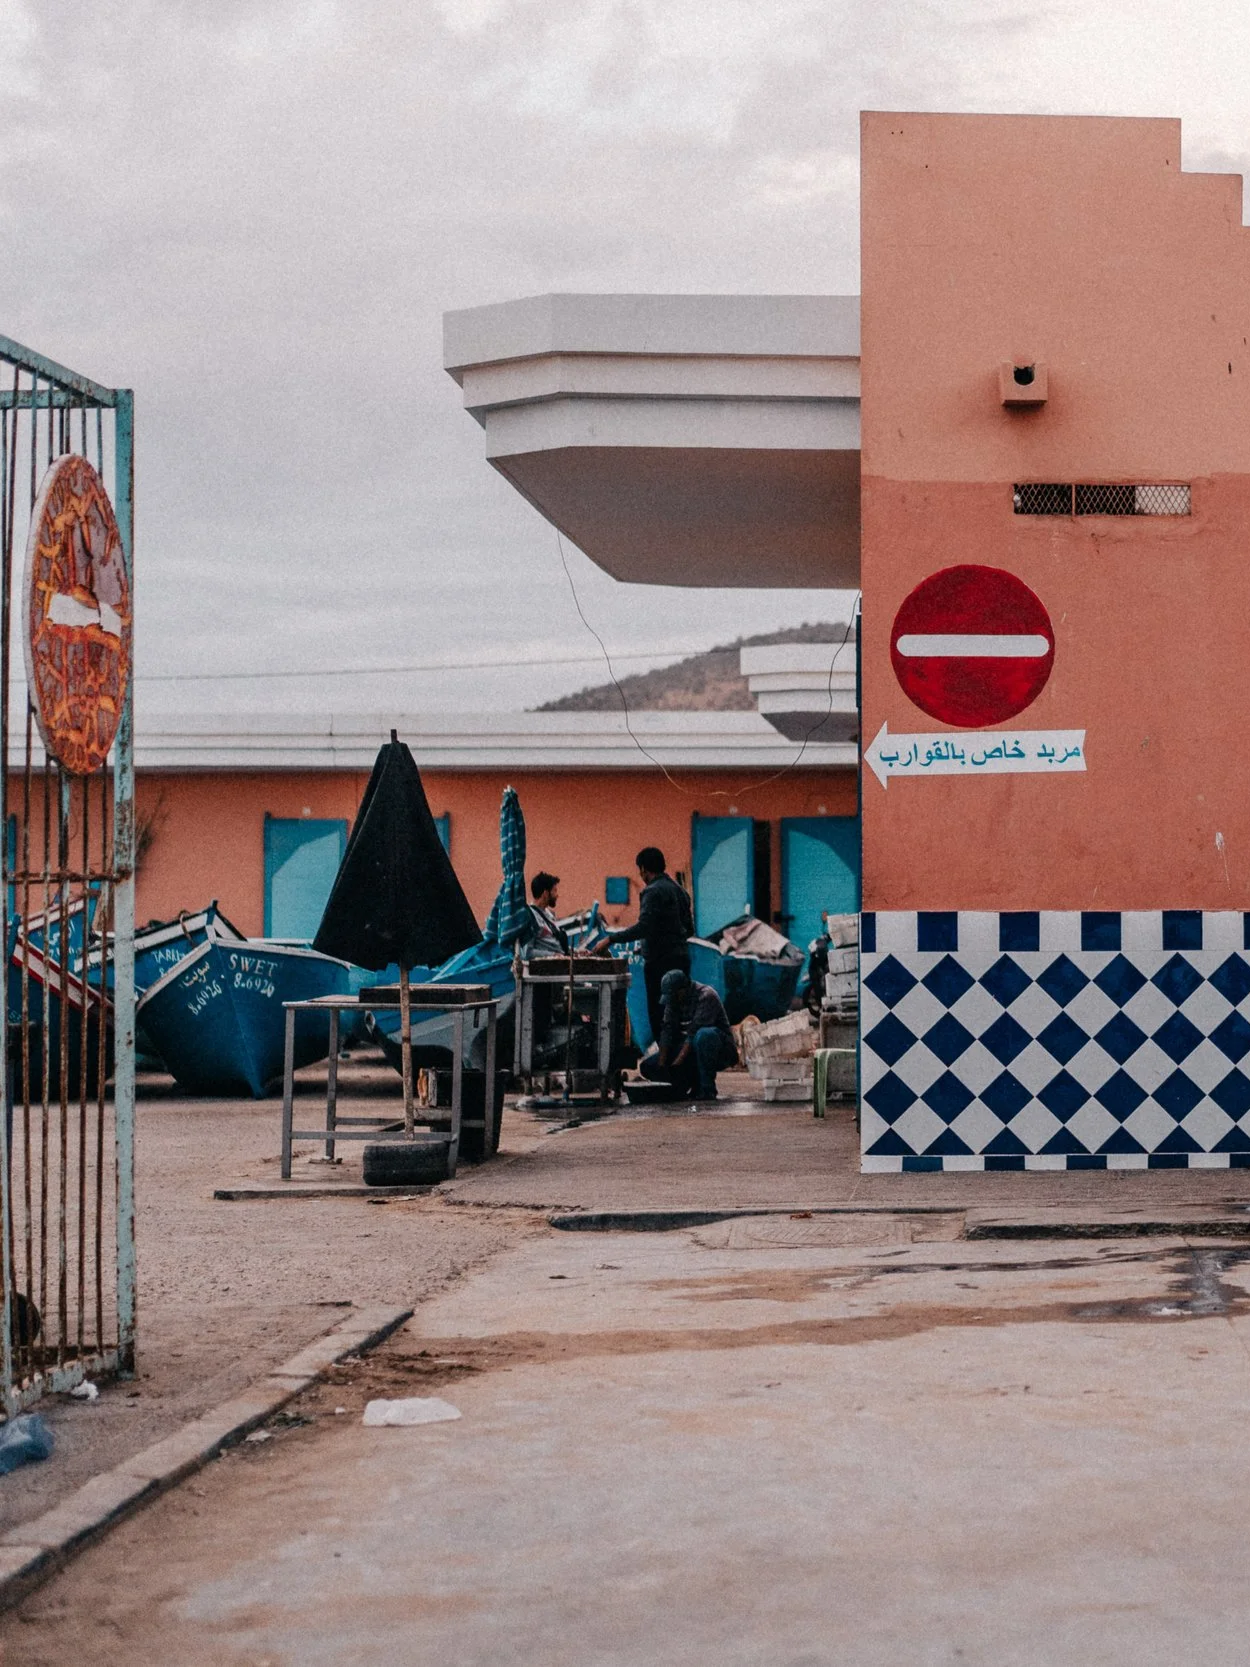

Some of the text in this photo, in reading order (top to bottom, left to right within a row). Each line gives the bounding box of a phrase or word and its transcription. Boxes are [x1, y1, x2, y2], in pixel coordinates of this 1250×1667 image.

[879, 740, 965, 767] بالقوارب
[970, 739, 1026, 766] خاص
[229, 953, 278, 977] SWET
